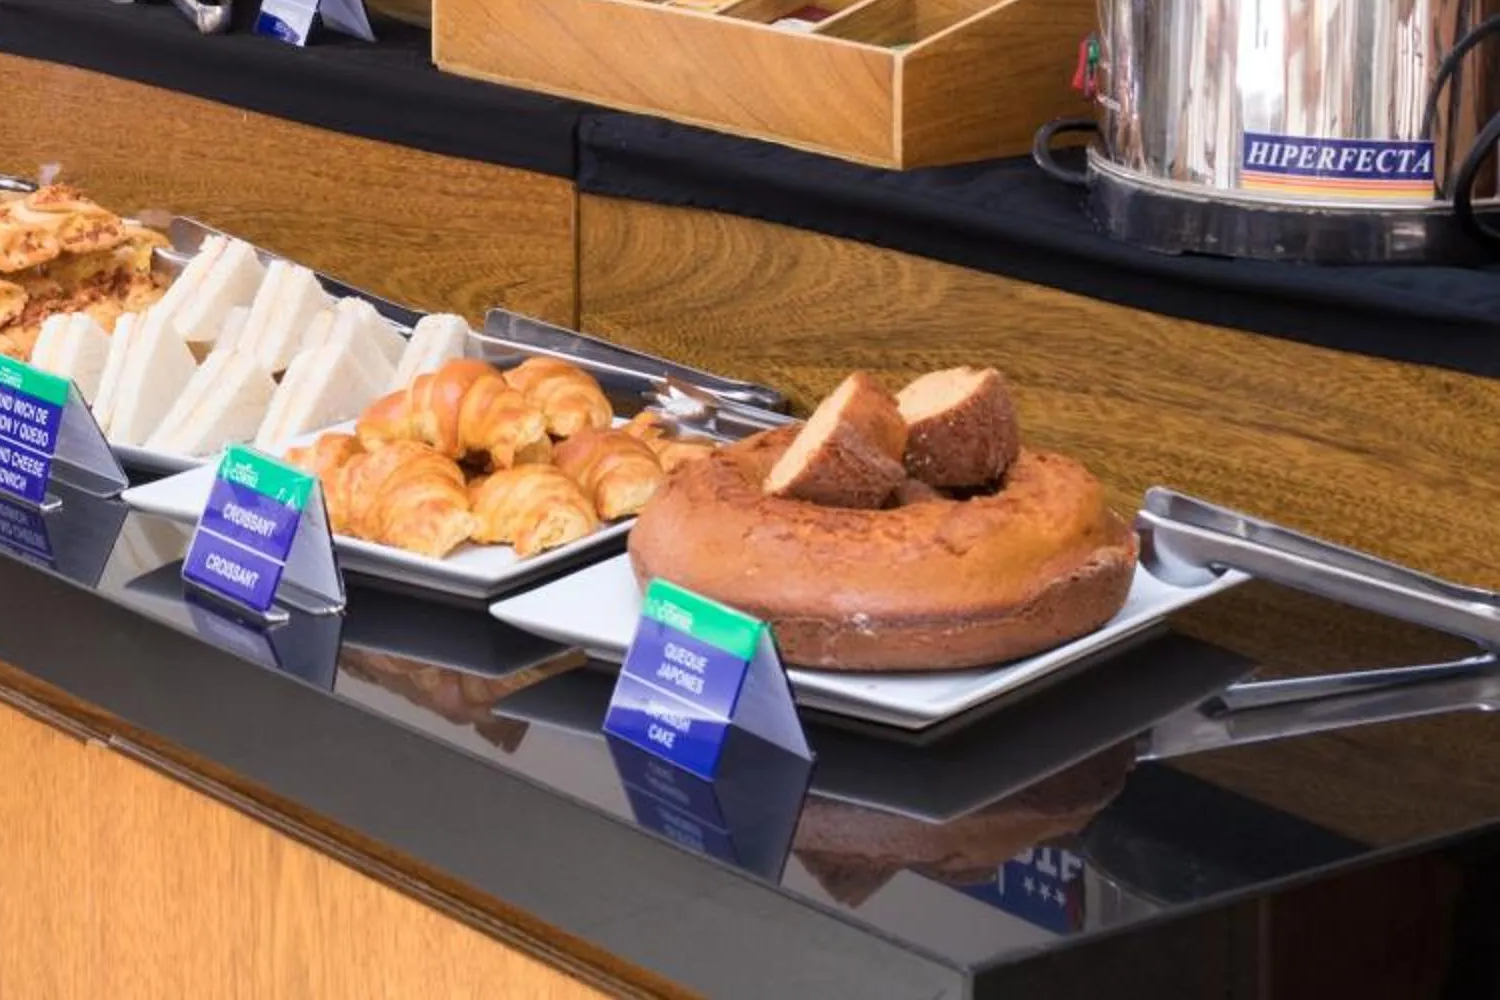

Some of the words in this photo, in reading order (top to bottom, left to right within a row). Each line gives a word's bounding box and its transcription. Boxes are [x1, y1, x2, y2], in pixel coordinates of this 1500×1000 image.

[1247, 141, 1432, 174] HIPERFECTA
[36, 408, 49, 426] DE
[12, 419, 20, 435] Y
[19, 424, 49, 447] QUESO
[11, 452, 45, 478] CHEESE
[222, 503, 277, 538] CROISSANT
[205, 553, 260, 588] CROISSANT
[665, 642, 709, 674] QUEQUE
[647, 723, 677, 749] CAKE
